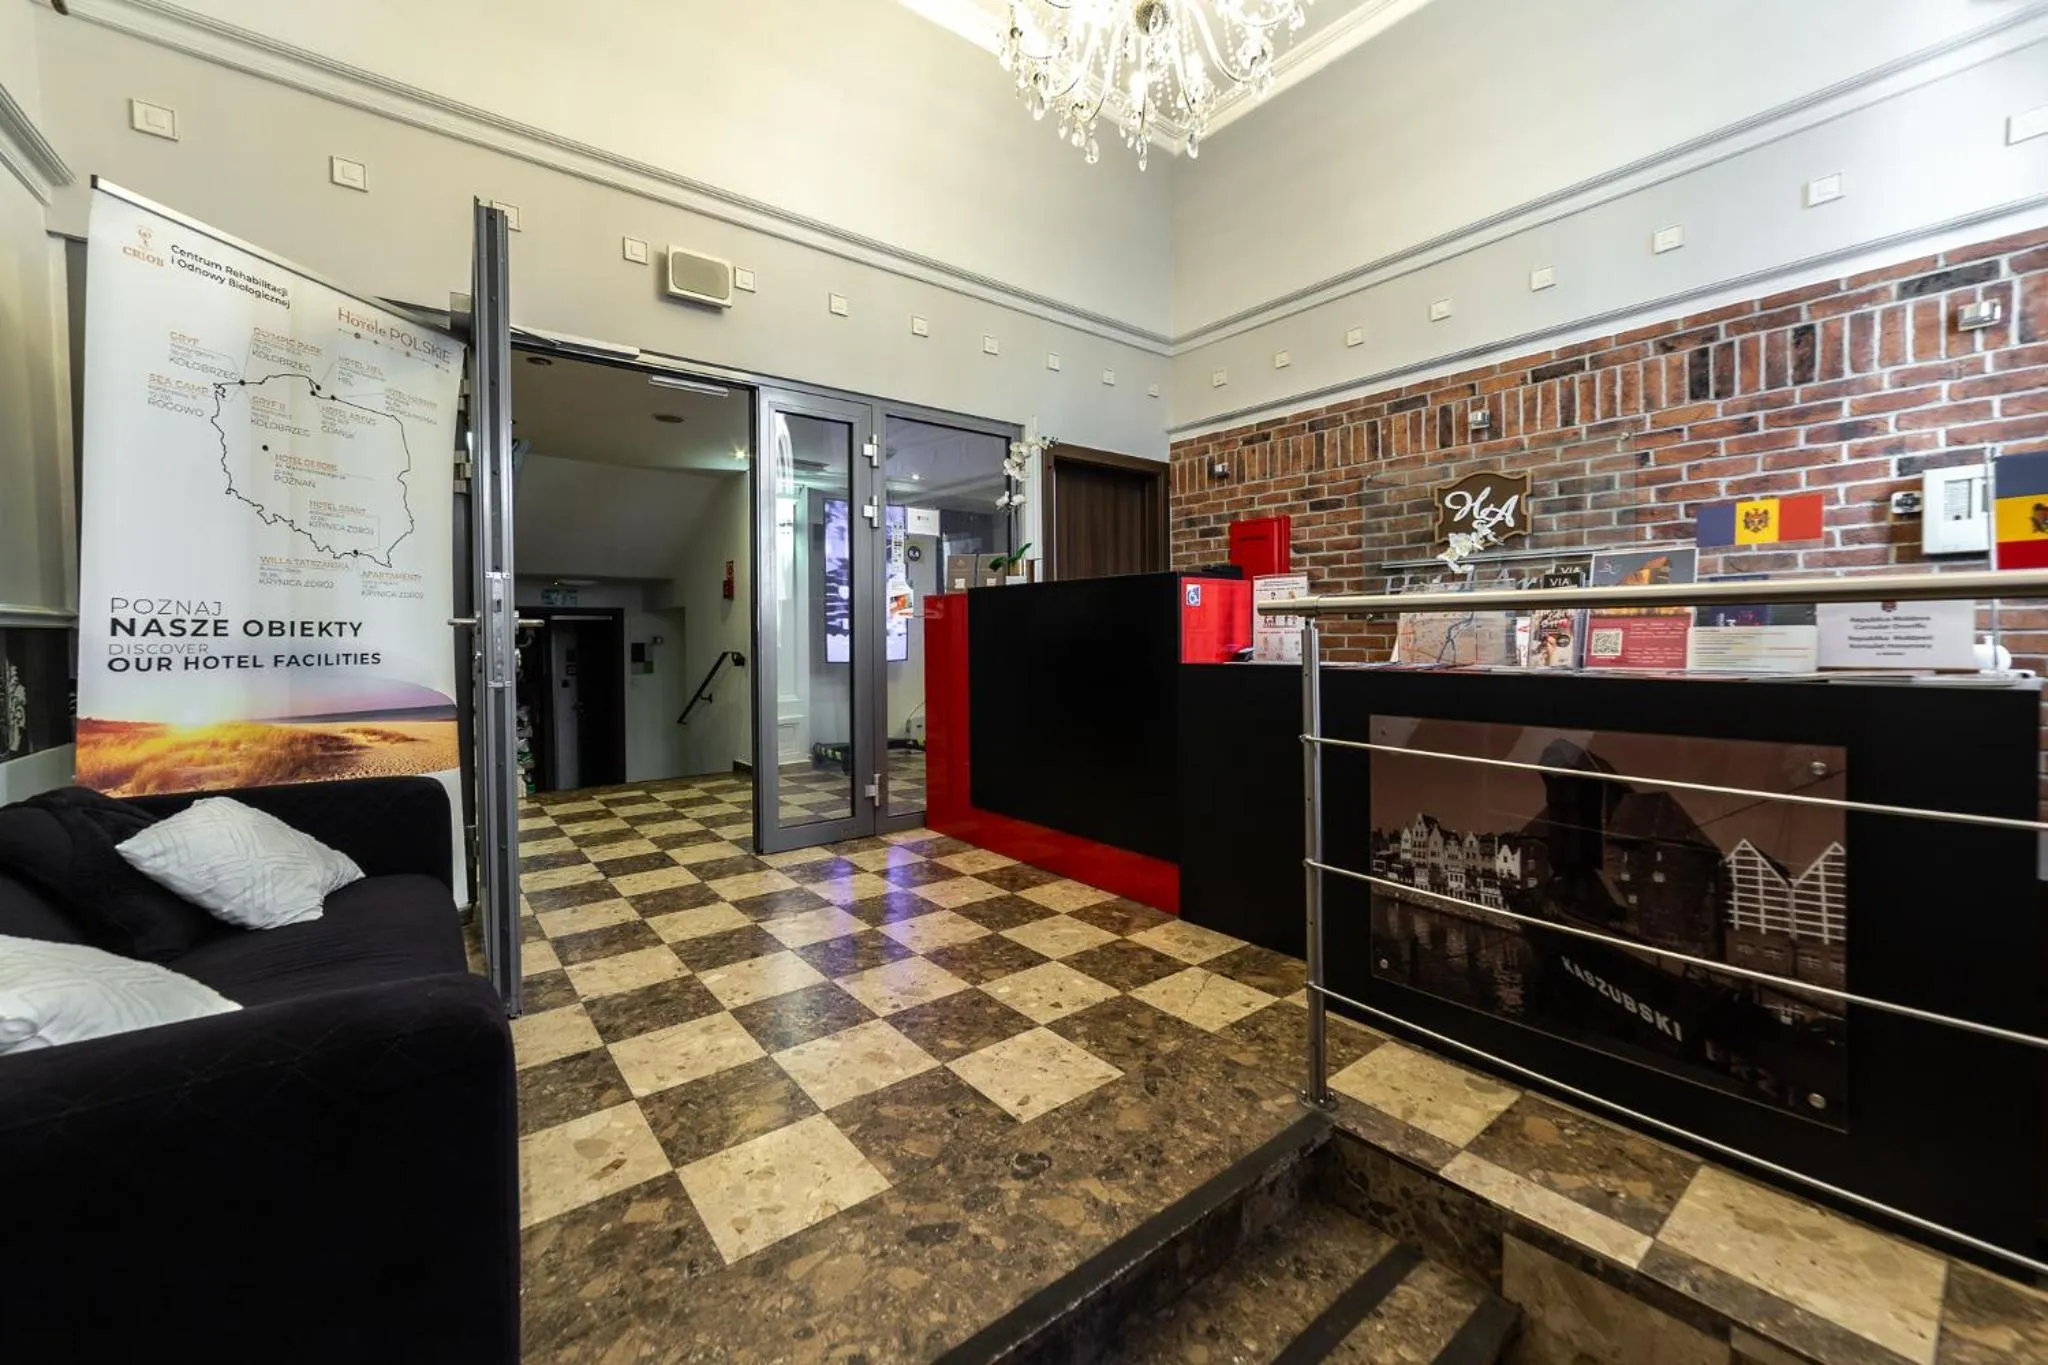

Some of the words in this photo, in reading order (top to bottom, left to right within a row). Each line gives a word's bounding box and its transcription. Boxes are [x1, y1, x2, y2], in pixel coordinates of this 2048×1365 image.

[171, 244, 222, 271] Centrum
[225, 265, 288, 297] Rehabilitacji
[177, 258, 225, 285] Odnowy
[228, 278, 290, 310] Biologicznej
[337, 306, 386, 337] Hotele
[390, 327, 451, 365] POLSKIE
[1550, 577, 1570, 587] VIA
[110, 597, 222, 617] POZNAJ
[110, 617, 229, 638] NASZE
[242, 619, 363, 638] OBIEKTY
[108, 642, 209, 656] DISCOVER
[107, 656, 172, 673] OUR
[184, 654, 264, 671] HOTEL
[273, 652, 382, 668] FACILITIES
[1560, 954, 1684, 1043] KASZUBSKI
